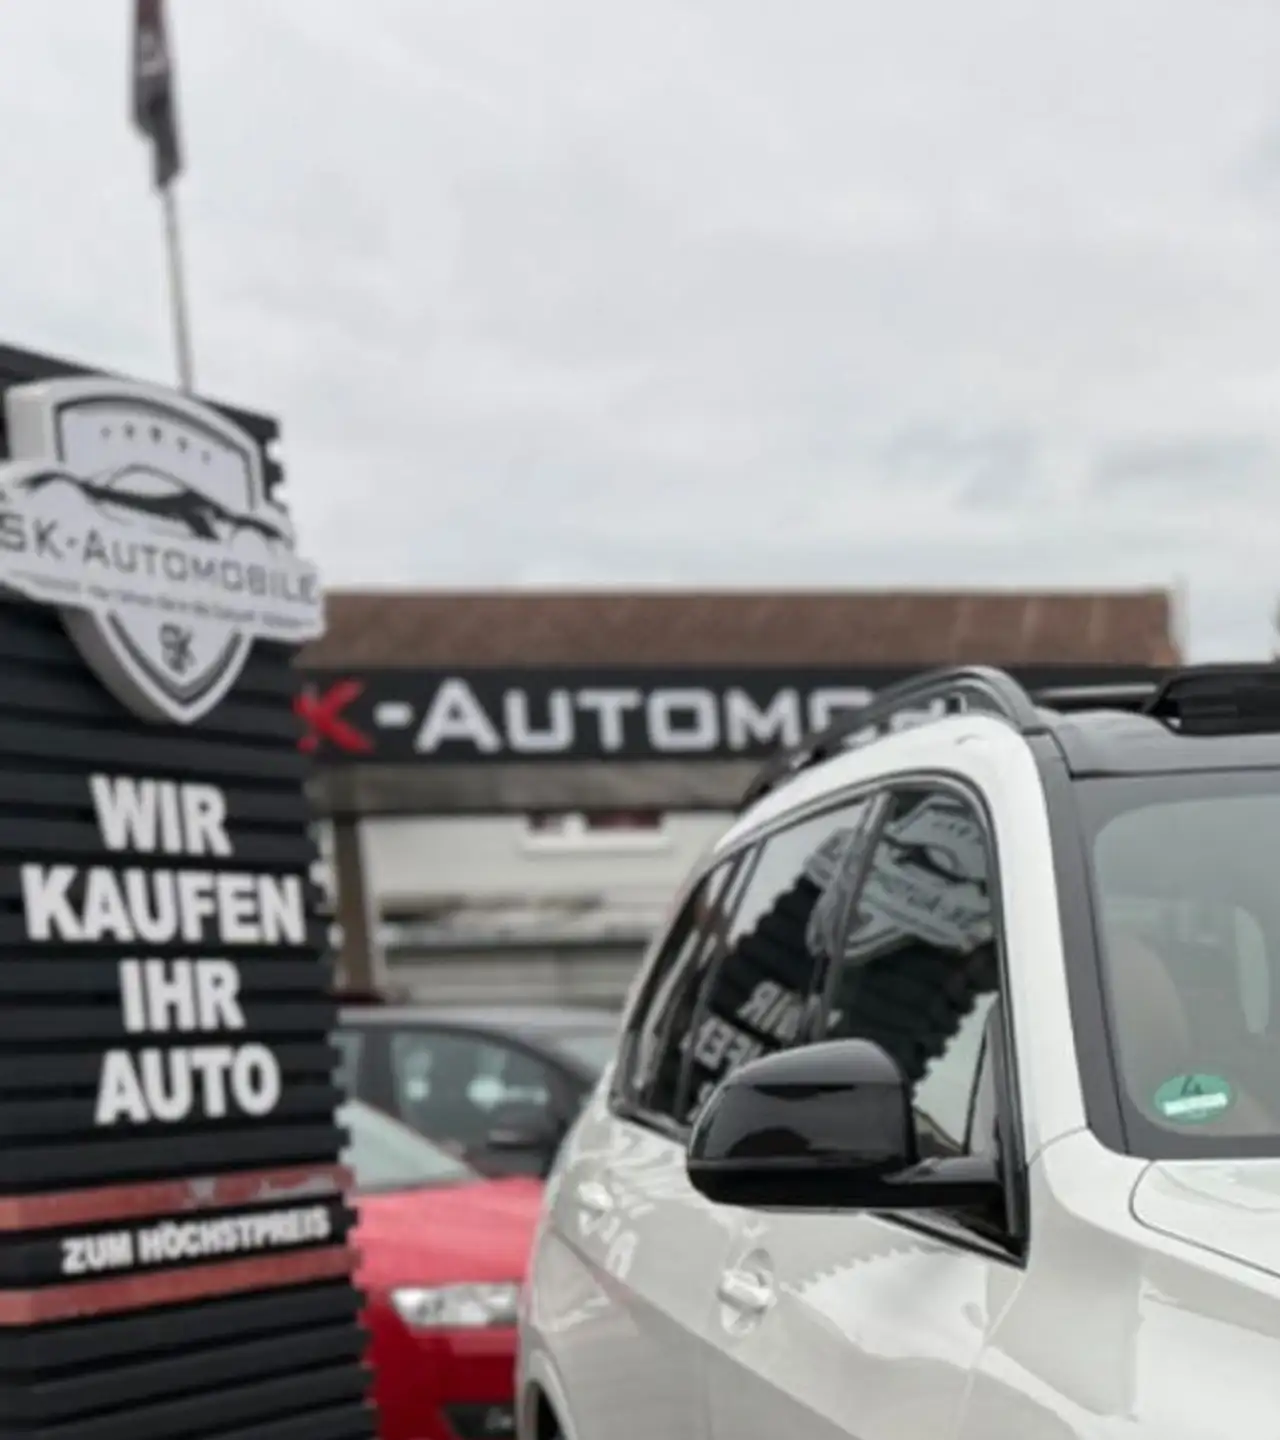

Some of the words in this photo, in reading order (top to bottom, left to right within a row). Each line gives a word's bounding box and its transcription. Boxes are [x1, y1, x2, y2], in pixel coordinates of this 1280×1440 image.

[90, 774, 232, 856] WIR
[21, 863, 306, 945] KAUFEN
[119, 958, 245, 1033] IHR
[94, 1043, 281, 1125] AUTO
[62, 1221, 133, 1274] ZUM
